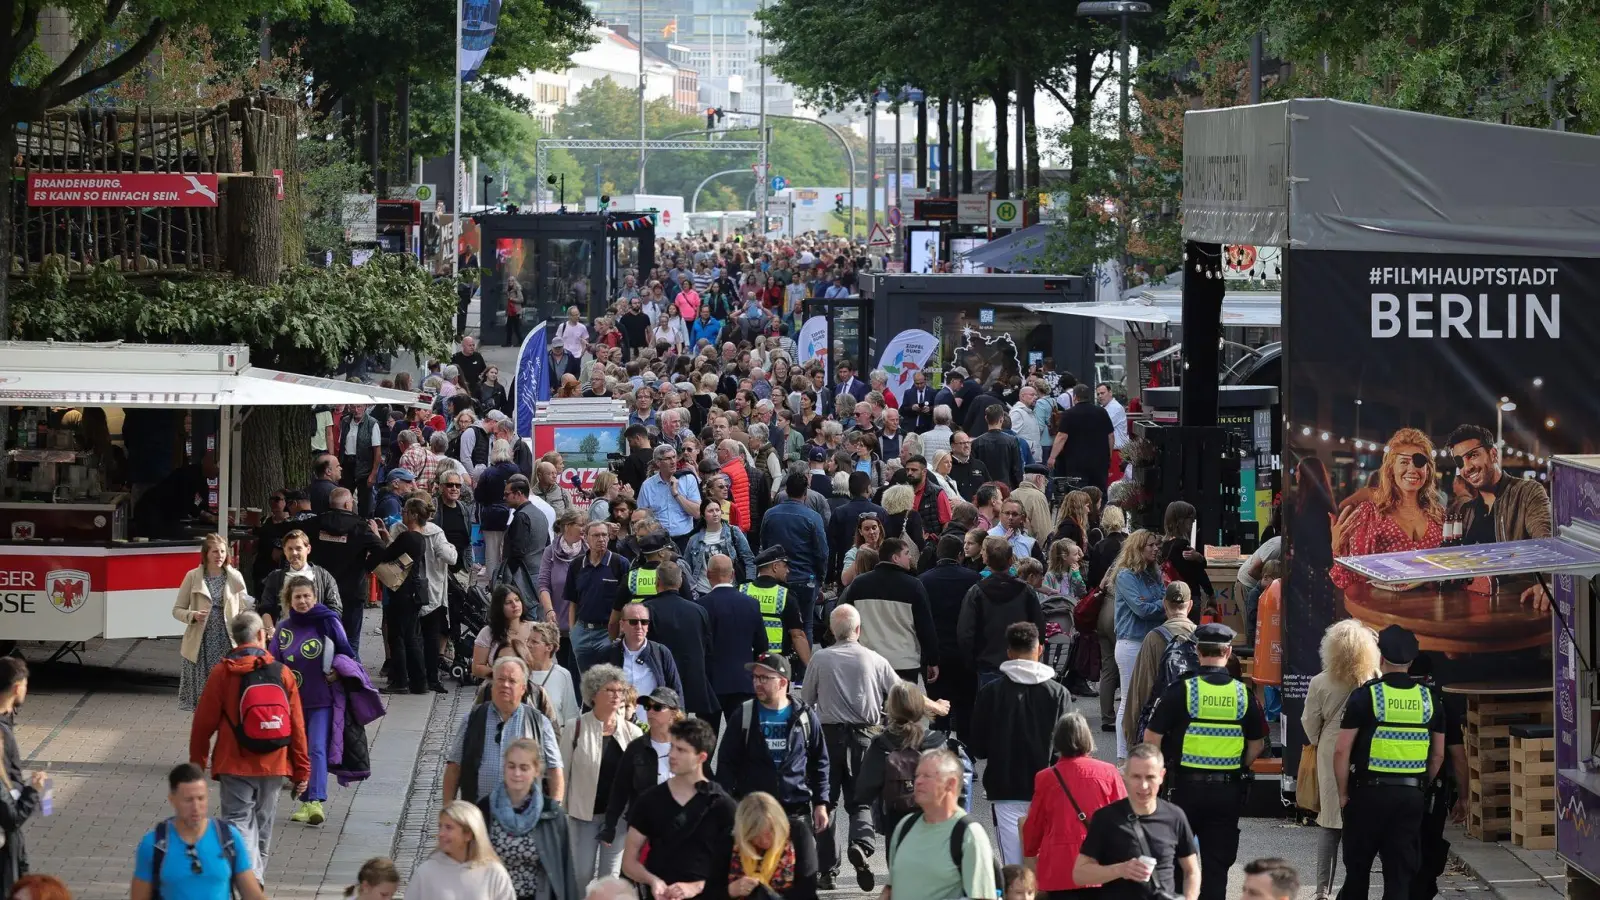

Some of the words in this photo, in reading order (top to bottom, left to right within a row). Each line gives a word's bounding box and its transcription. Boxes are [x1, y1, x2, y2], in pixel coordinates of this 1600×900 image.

[34, 178, 123, 189] BRANDENBURG.
[34, 191, 47, 201] ES
[49, 191, 80, 201] KANN
[83, 191, 100, 201] SO
[101, 191, 150, 201] EINFACH
[152, 191, 180, 201] SEIN.
[1369, 267, 1559, 286] #FILMHAUPTSTADT
[1371, 293, 1560, 339] BERLIN
[0, 593, 36, 613] SE
[1202, 695, 1235, 708] POLIZEI
[1387, 698, 1420, 711] POLIZEI
